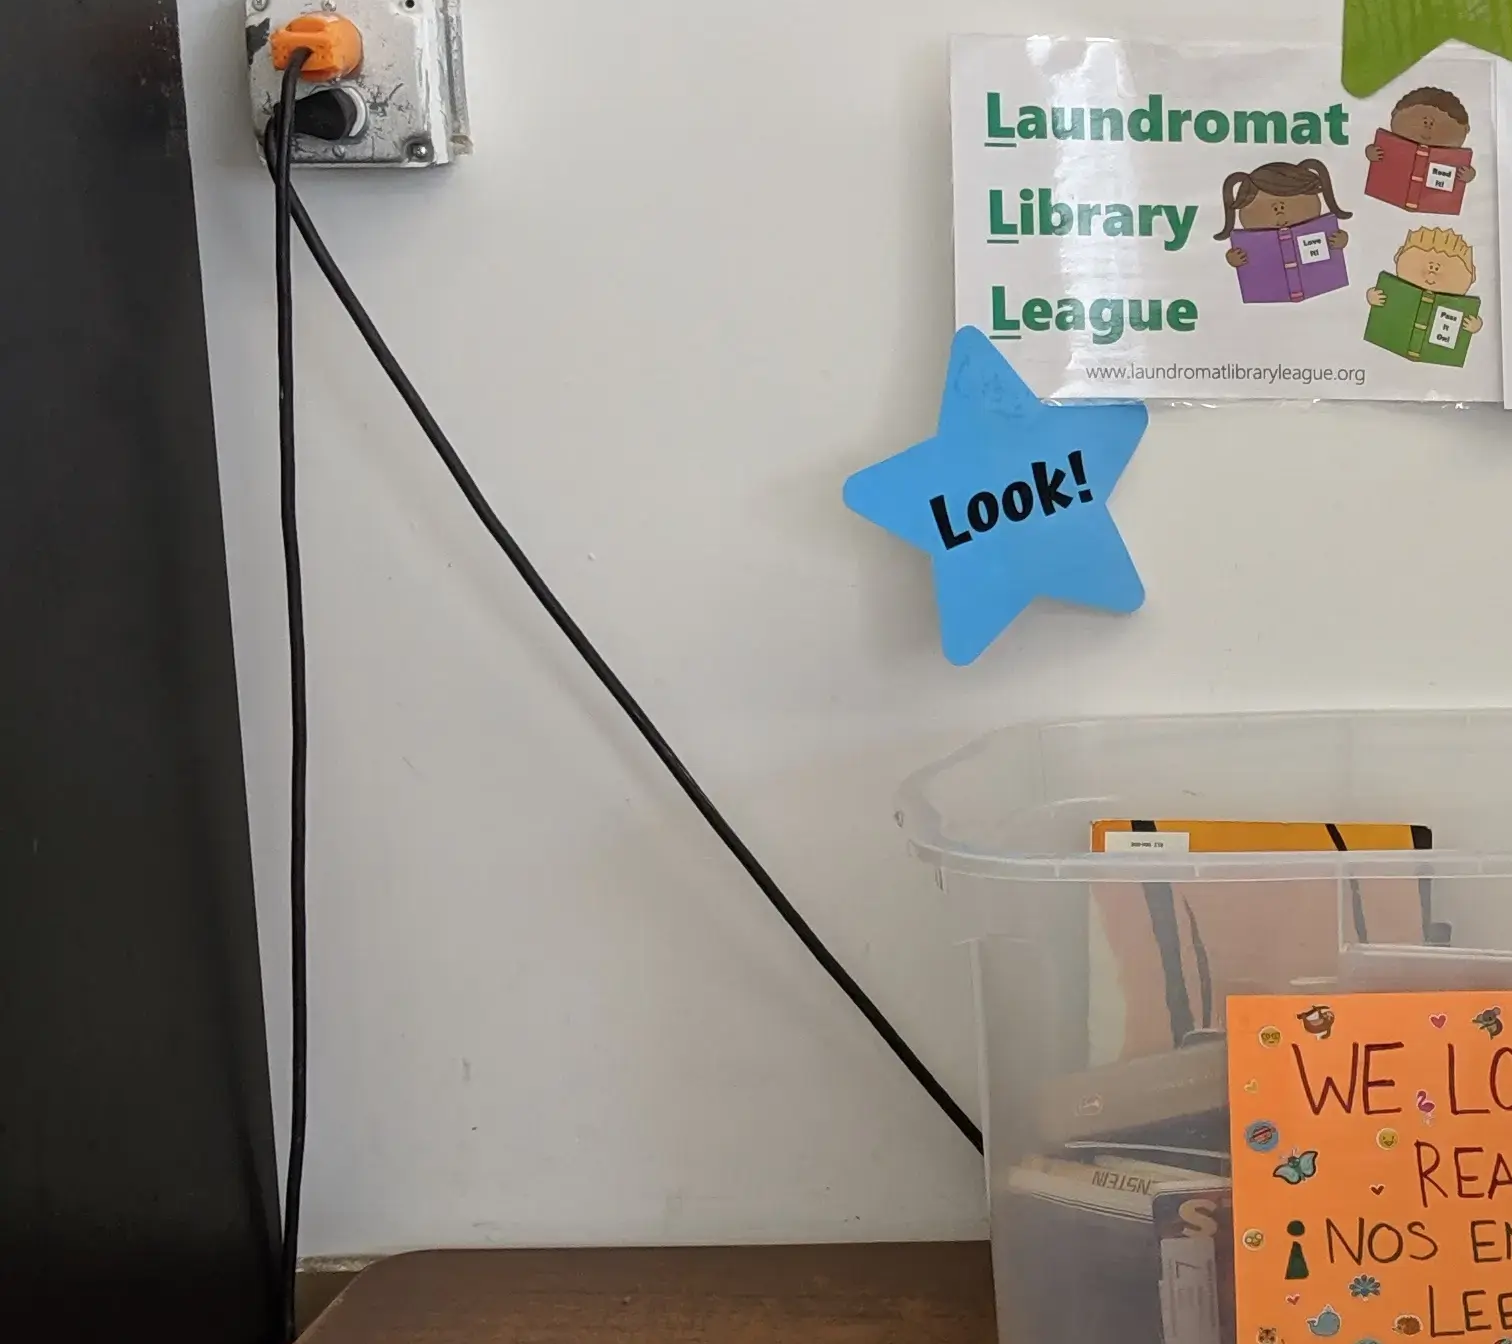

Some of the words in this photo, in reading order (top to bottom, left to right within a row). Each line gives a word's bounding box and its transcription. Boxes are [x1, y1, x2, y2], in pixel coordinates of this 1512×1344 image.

[984, 92, 1350, 146] Laundromat
[988, 189, 1199, 251] Library
[989, 286, 1199, 344] League
[1086, 362, 1366, 385] www.laundromatlibraryleague.org
[929, 449, 1094, 550] Look!
[1292, 1042, 1404, 1116] WE
